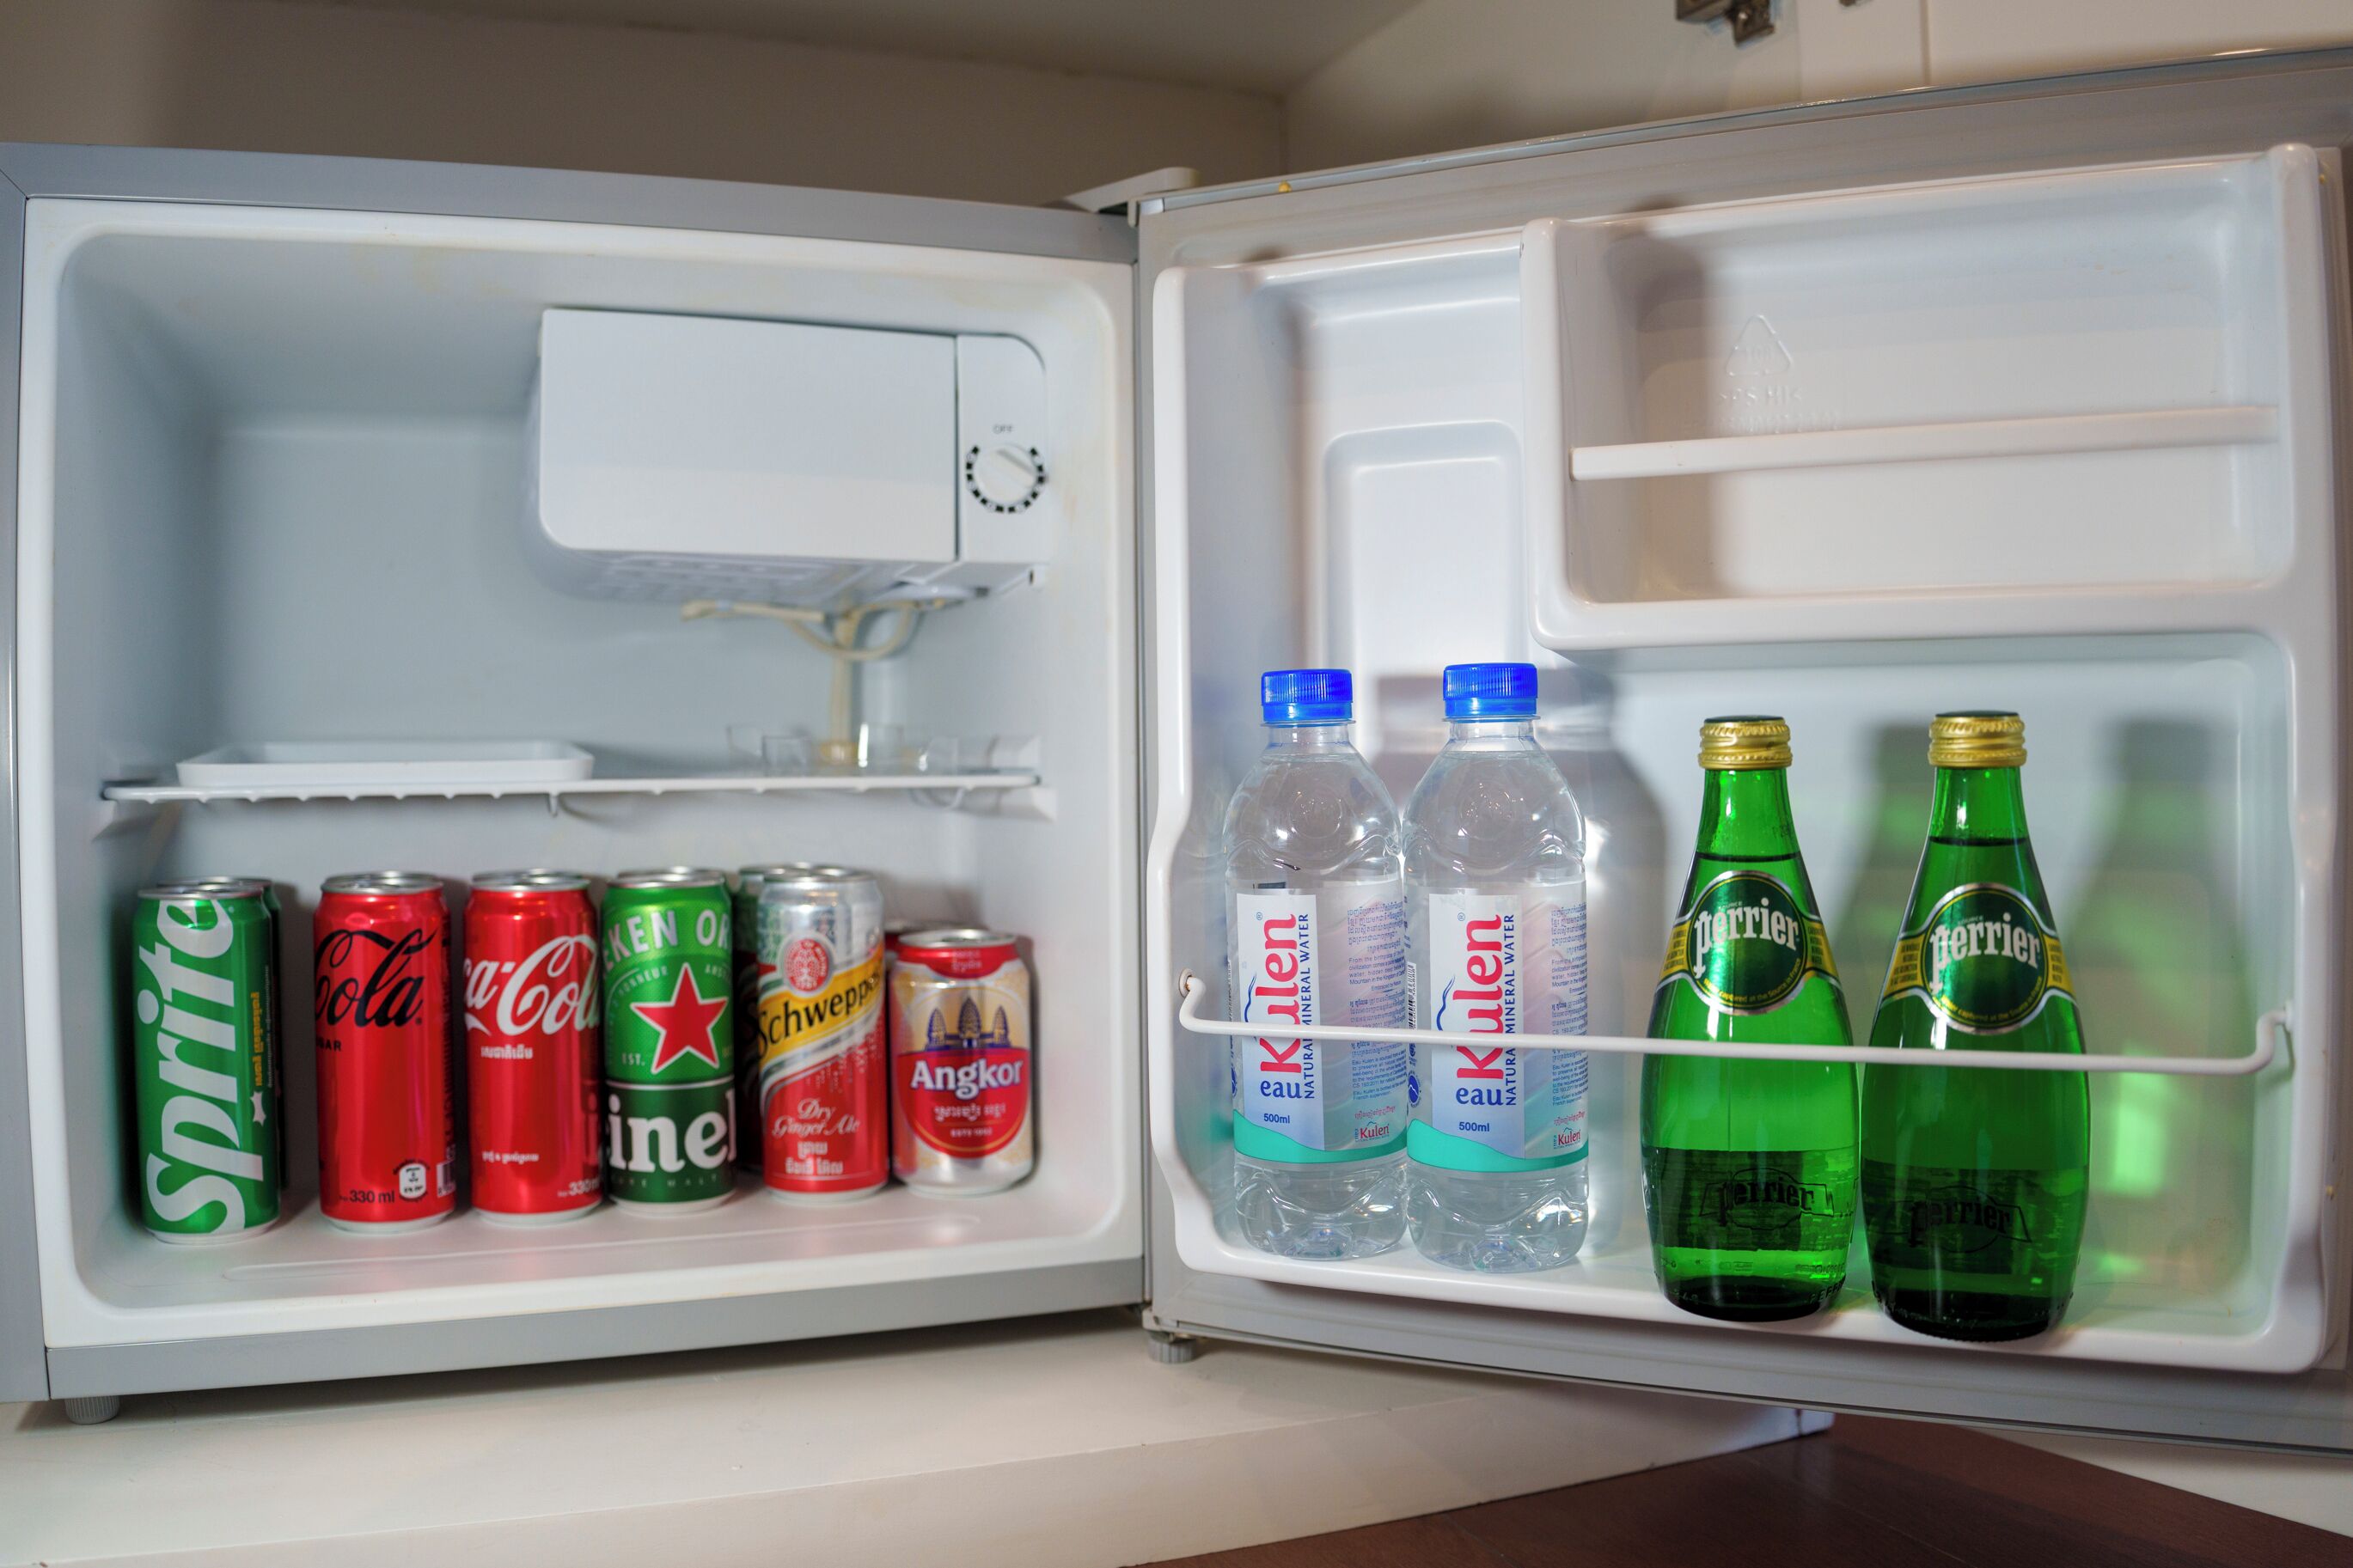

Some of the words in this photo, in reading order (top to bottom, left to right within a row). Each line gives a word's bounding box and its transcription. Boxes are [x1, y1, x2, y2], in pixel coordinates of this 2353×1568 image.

[1299, 914, 1310, 963] WATER
[1503, 914, 1515, 968] WATER
[1255, 913, 1302, 1073] Kulen
[1452, 914, 1503, 1080] Kulen
[1504, 970, 1516, 1034] MINERAL
[137, 900, 263, 1234] Sprite
[910, 1059, 1024, 1100] Angkor
[1505, 1047, 1517, 1106] NATURA
[1260, 1081, 1302, 1100] eau
[1456, 1087, 1504, 1107] eau
[1263, 1113, 1290, 1124] 500ml
[1360, 1123, 1390, 1139] Kulen
[1458, 1121, 1489, 1133] 500ml
[1557, 1129, 1580, 1146] Kulen
[349, 1189, 375, 1204] 330
[378, 1189, 394, 1203] ml
